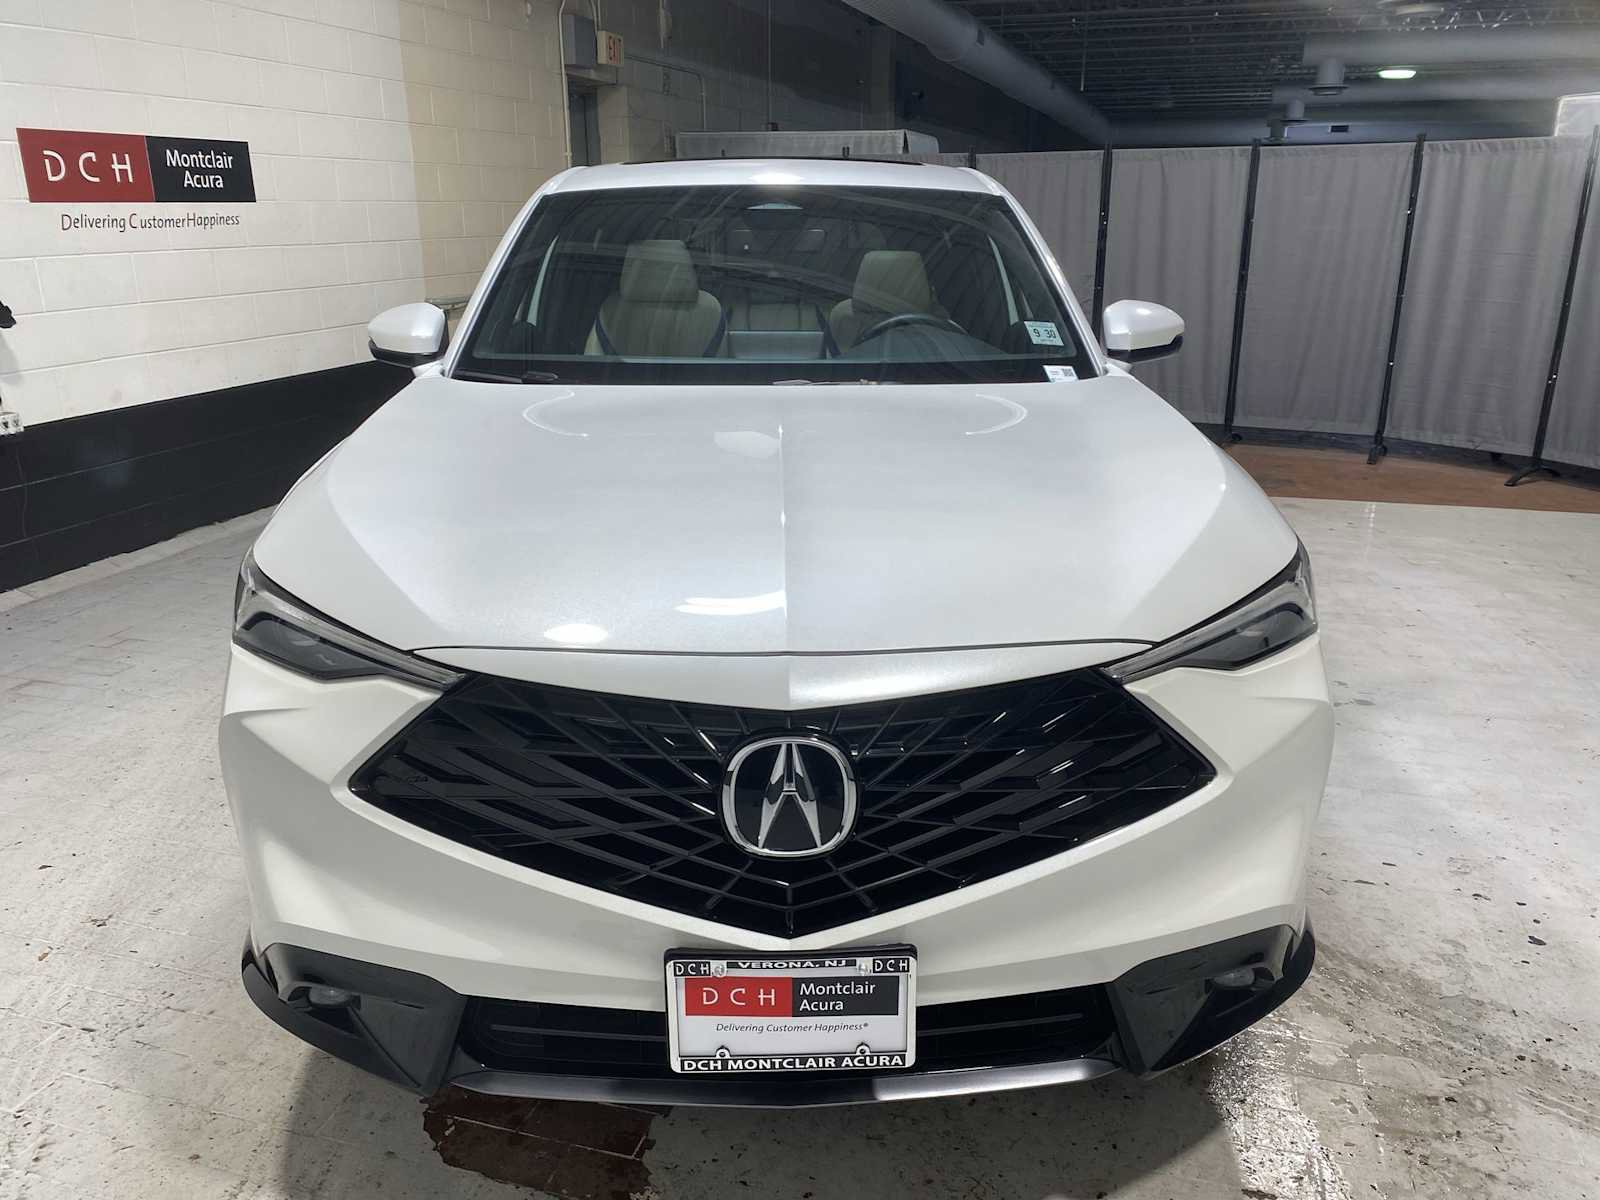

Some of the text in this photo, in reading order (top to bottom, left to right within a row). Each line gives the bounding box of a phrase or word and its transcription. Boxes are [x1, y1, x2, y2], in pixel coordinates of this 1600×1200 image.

[166, 149, 233, 169] Montclair
[183, 170, 224, 188] Acura
[61, 213, 127, 233] Delivering
[1033, 328, 1040, 338] 9
[738, 959, 847, 970] VERONA, NJ
[799, 981, 876, 996] Montclair
[799, 999, 844, 1012] Acura
[716, 1022, 764, 1034] Delivering
[766, 1022, 813, 1032] Customer
[684, 1054, 904, 1071] DCH MONTCLAIR ACURA
